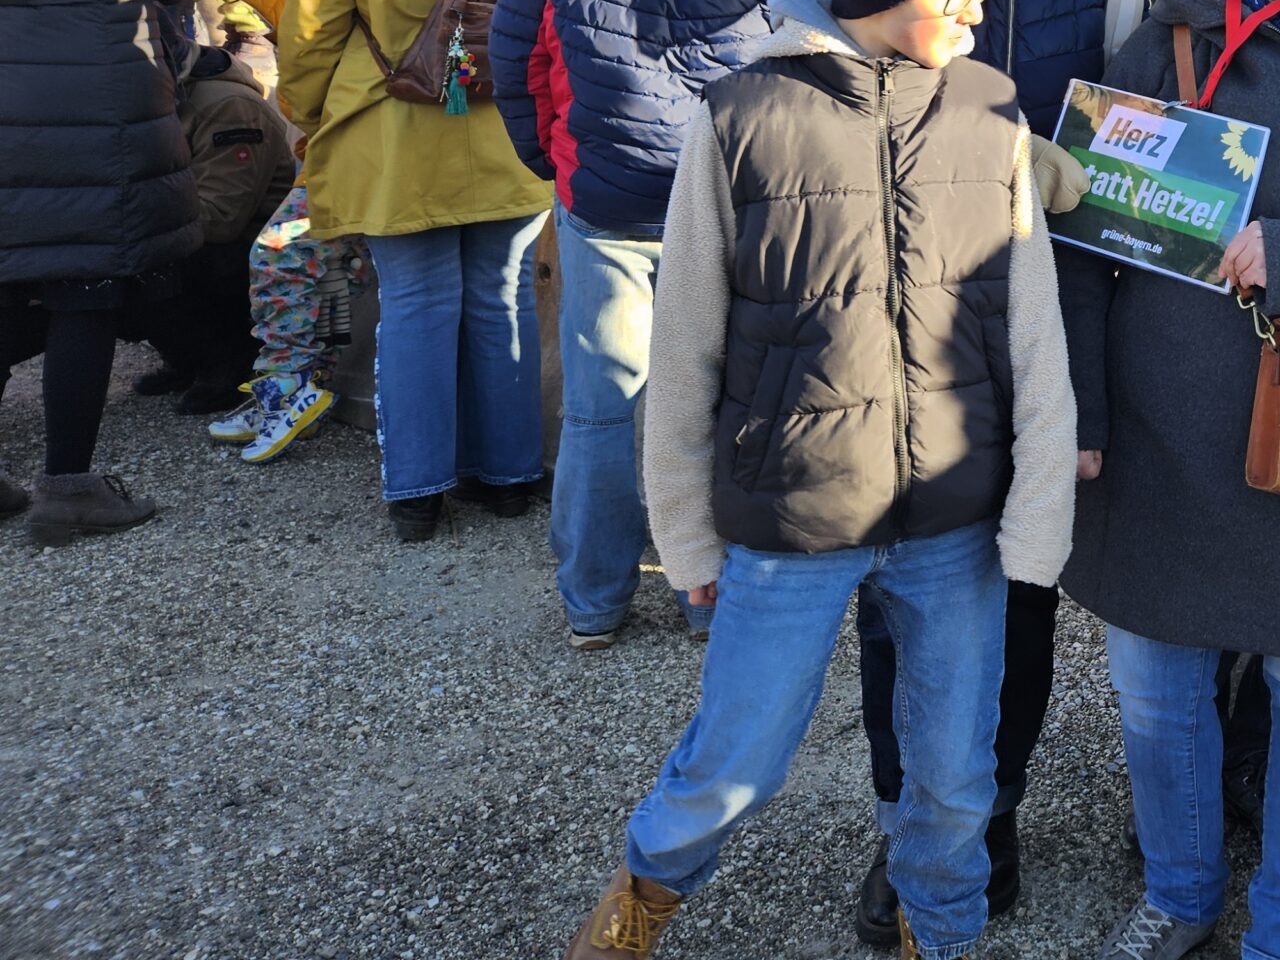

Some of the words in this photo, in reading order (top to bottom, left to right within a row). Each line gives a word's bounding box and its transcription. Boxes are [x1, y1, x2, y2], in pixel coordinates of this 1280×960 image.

[1103, 117, 1169, 159] Herz
[1084, 163, 1132, 203] tatt
[1134, 178, 1225, 231] Hetze!
[1101, 227, 1163, 255] grüne-bayern.de
